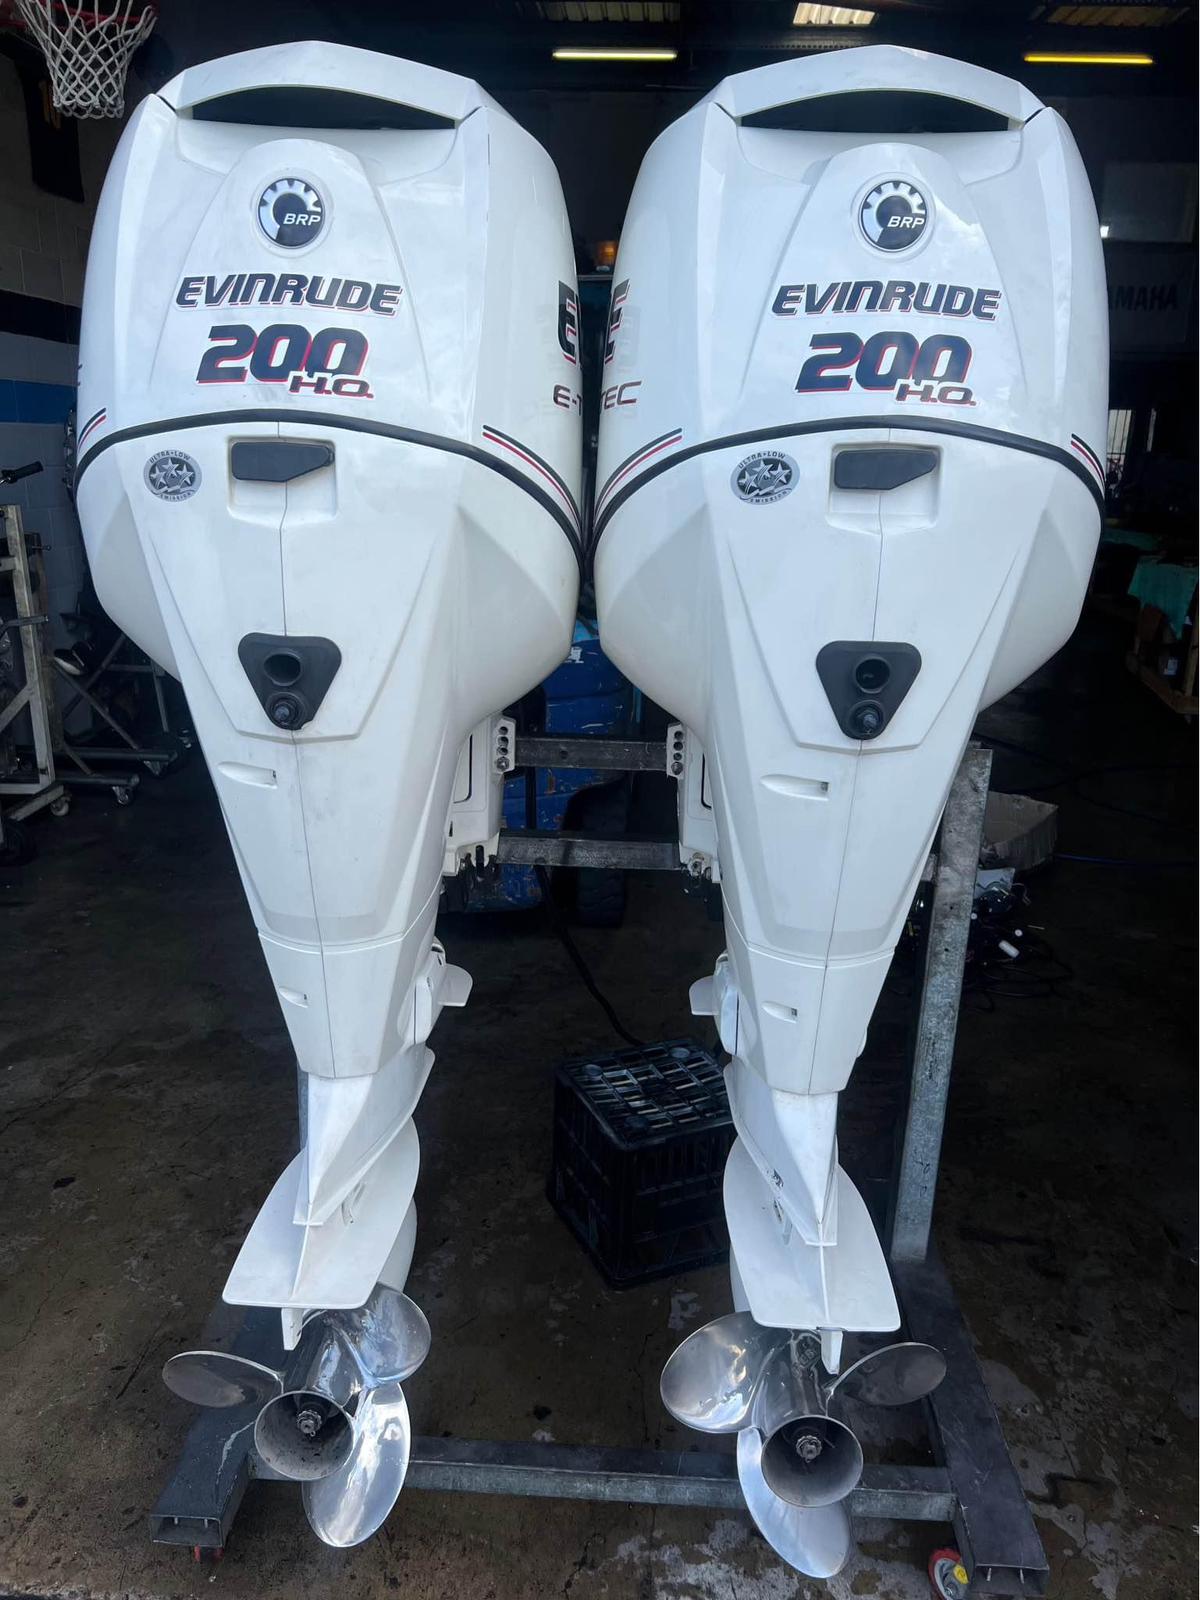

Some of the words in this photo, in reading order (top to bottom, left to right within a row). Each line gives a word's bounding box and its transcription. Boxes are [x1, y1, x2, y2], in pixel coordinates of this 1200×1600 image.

[283, 213, 321, 226] BRP
[887, 216, 925, 229] BRP
[175, 273, 403, 316] EVINRUDE
[771, 280, 1001, 321] EVINRUDE
[196, 324, 369, 384] 200
[794, 331, 972, 393] 200
